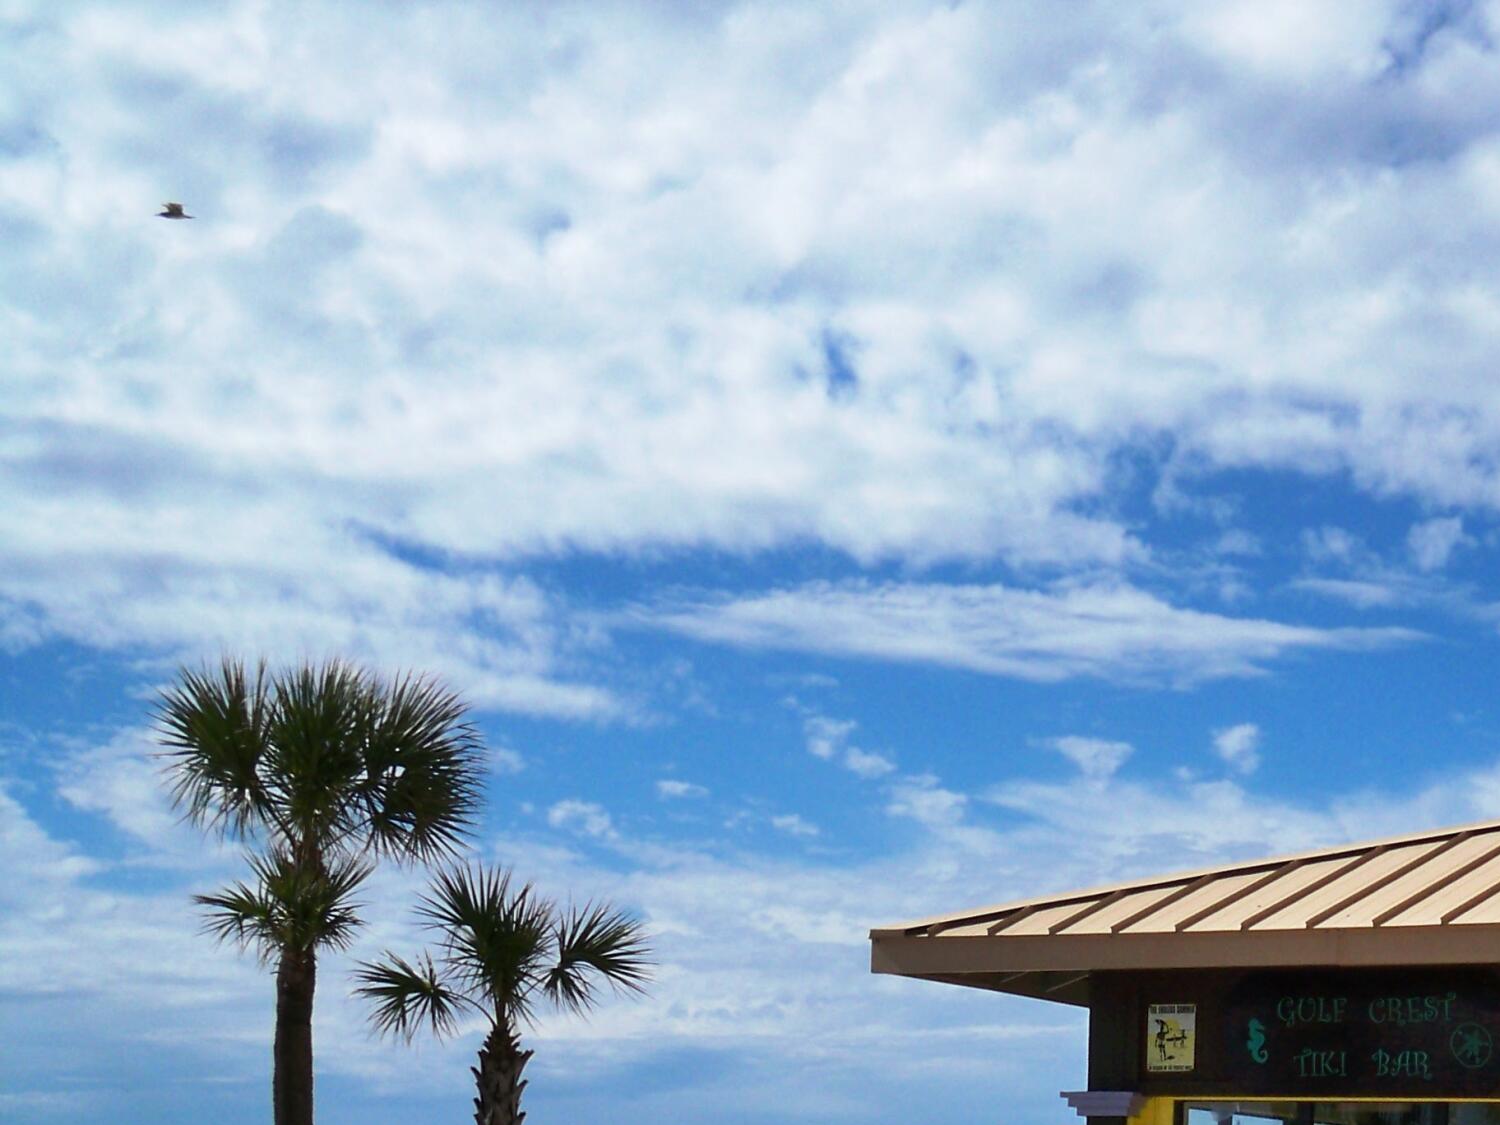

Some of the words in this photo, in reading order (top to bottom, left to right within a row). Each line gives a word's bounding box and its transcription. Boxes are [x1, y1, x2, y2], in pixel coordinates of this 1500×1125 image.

[1276, 996, 1348, 1026] GULF
[1368, 992, 1457, 1025] CREST
[1293, 1048, 1348, 1077] TIKI
[1371, 1047, 1433, 1080] BAR
